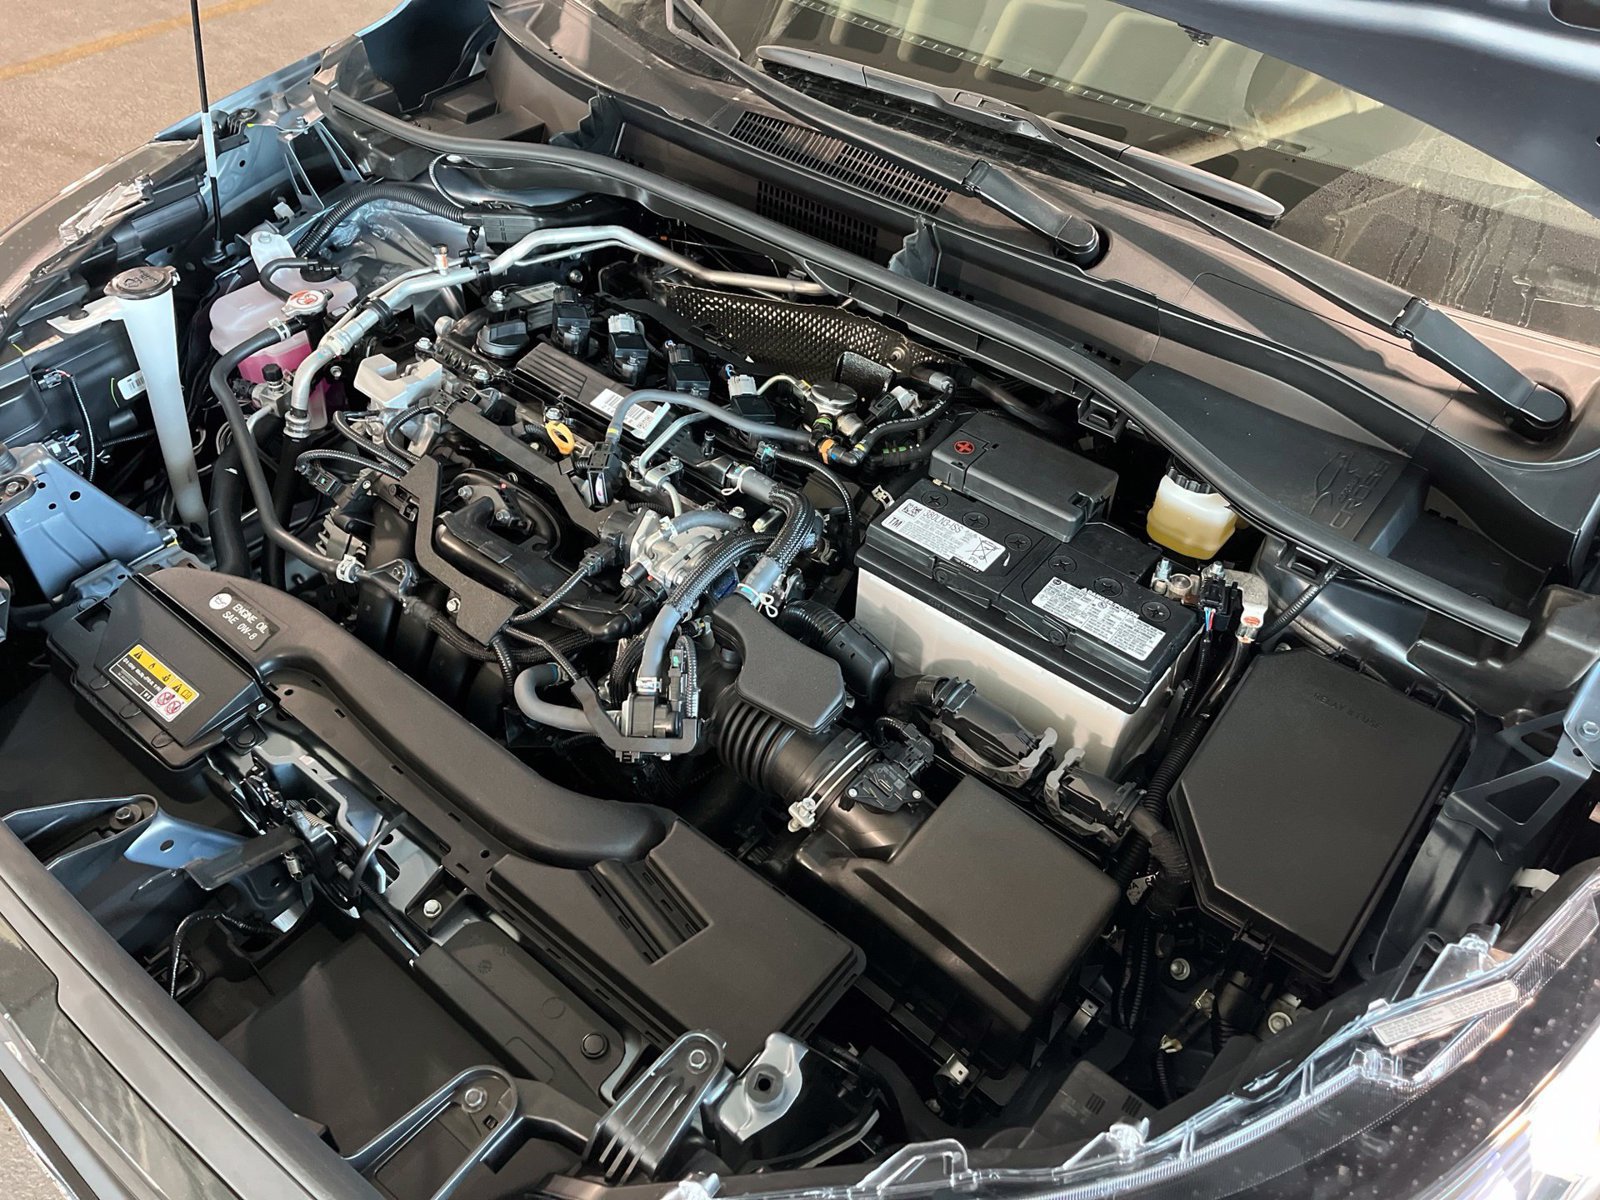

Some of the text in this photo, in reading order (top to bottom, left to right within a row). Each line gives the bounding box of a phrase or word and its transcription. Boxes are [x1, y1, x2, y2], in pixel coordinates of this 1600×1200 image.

[1329, 459, 1391, 529] CROSS
[889, 516, 903, 528] TM
[923, 510, 963, 533] 380LN3-ISS
[222, 611, 258, 640] SAE 0W-8
[232, 604, 268, 634] ENGINE OIL
